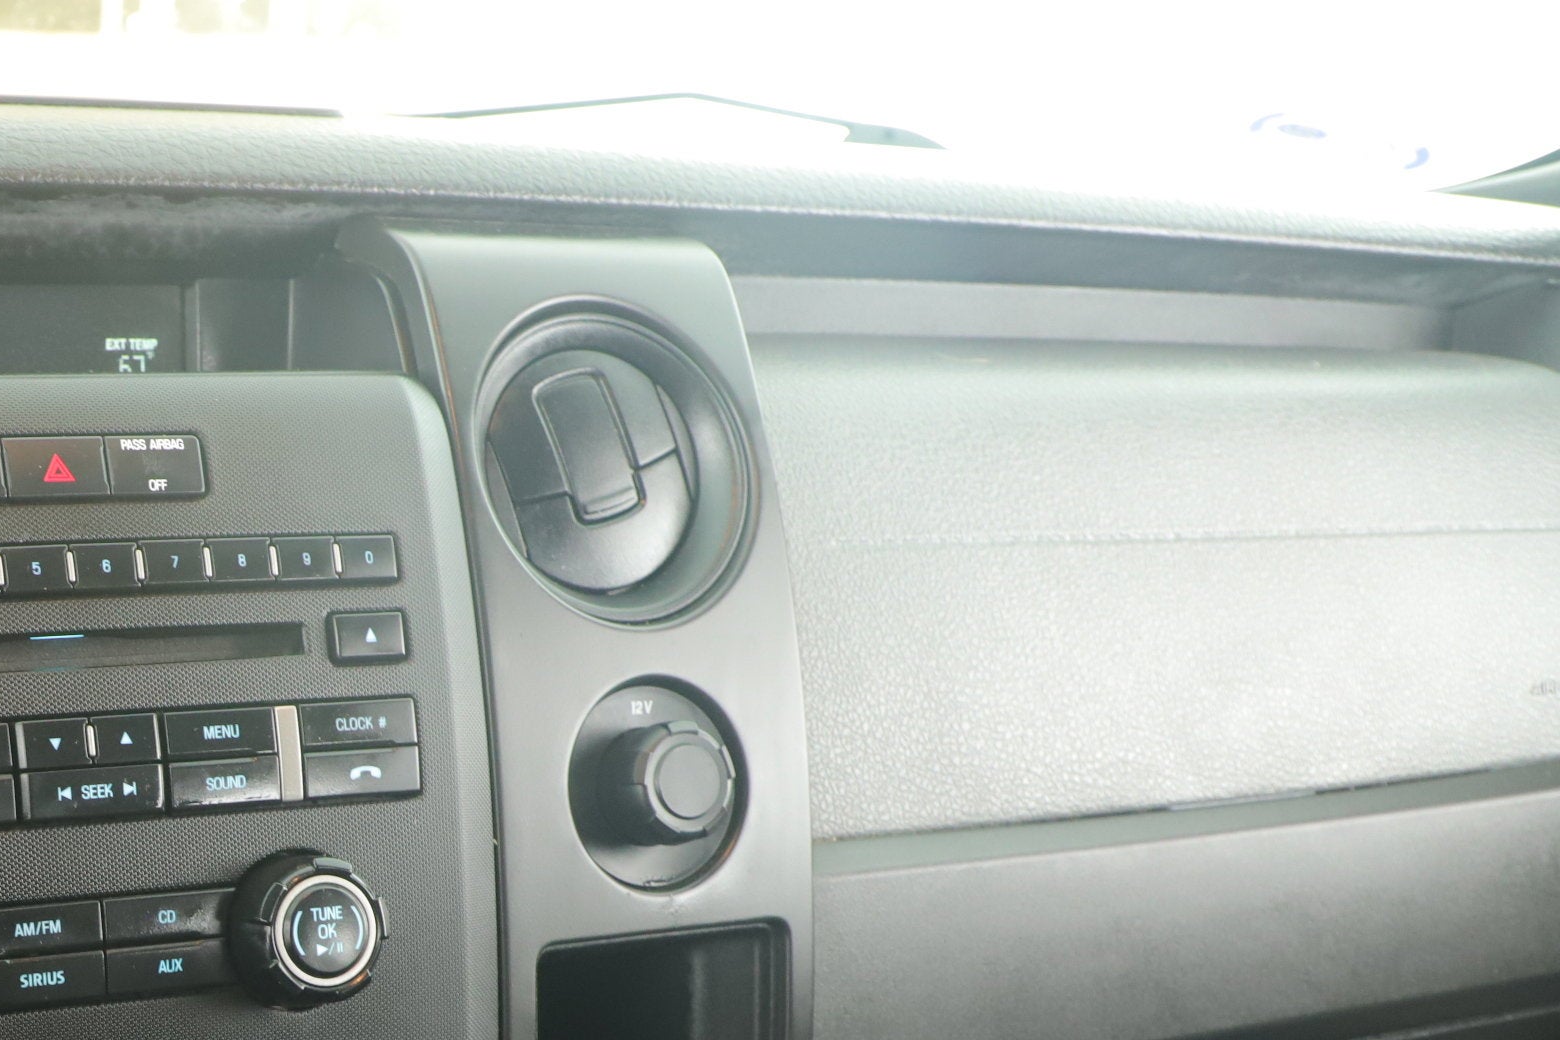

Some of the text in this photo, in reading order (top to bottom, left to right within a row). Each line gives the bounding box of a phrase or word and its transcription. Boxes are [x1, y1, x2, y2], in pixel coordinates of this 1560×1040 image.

[105, 337, 159, 351] EXT TEMP
[120, 438, 185, 451] PASS AIRBAG
[148, 478, 168, 492] OFF
[31, 561, 42, 576] 5
[101, 559, 112, 573] 6
[170, 555, 179, 569] 7
[237, 553, 247, 567] 8
[302, 552, 312, 566] 9
[364, 550, 374, 565] 0
[631, 699, 654, 715] 12V
[203, 724, 240, 740] MENU
[335, 716, 374, 732] CLOCK
[206, 775, 246, 791] SOUND
[81, 783, 114, 800] SEEK
[158, 909, 176, 924] CD
[310, 905, 343, 922] TUNE
[14, 919, 62, 938] AM/FM
[318, 923, 338, 940] OK
[158, 958, 183, 974] AUX
[19, 970, 66, 988] SIRIUS
